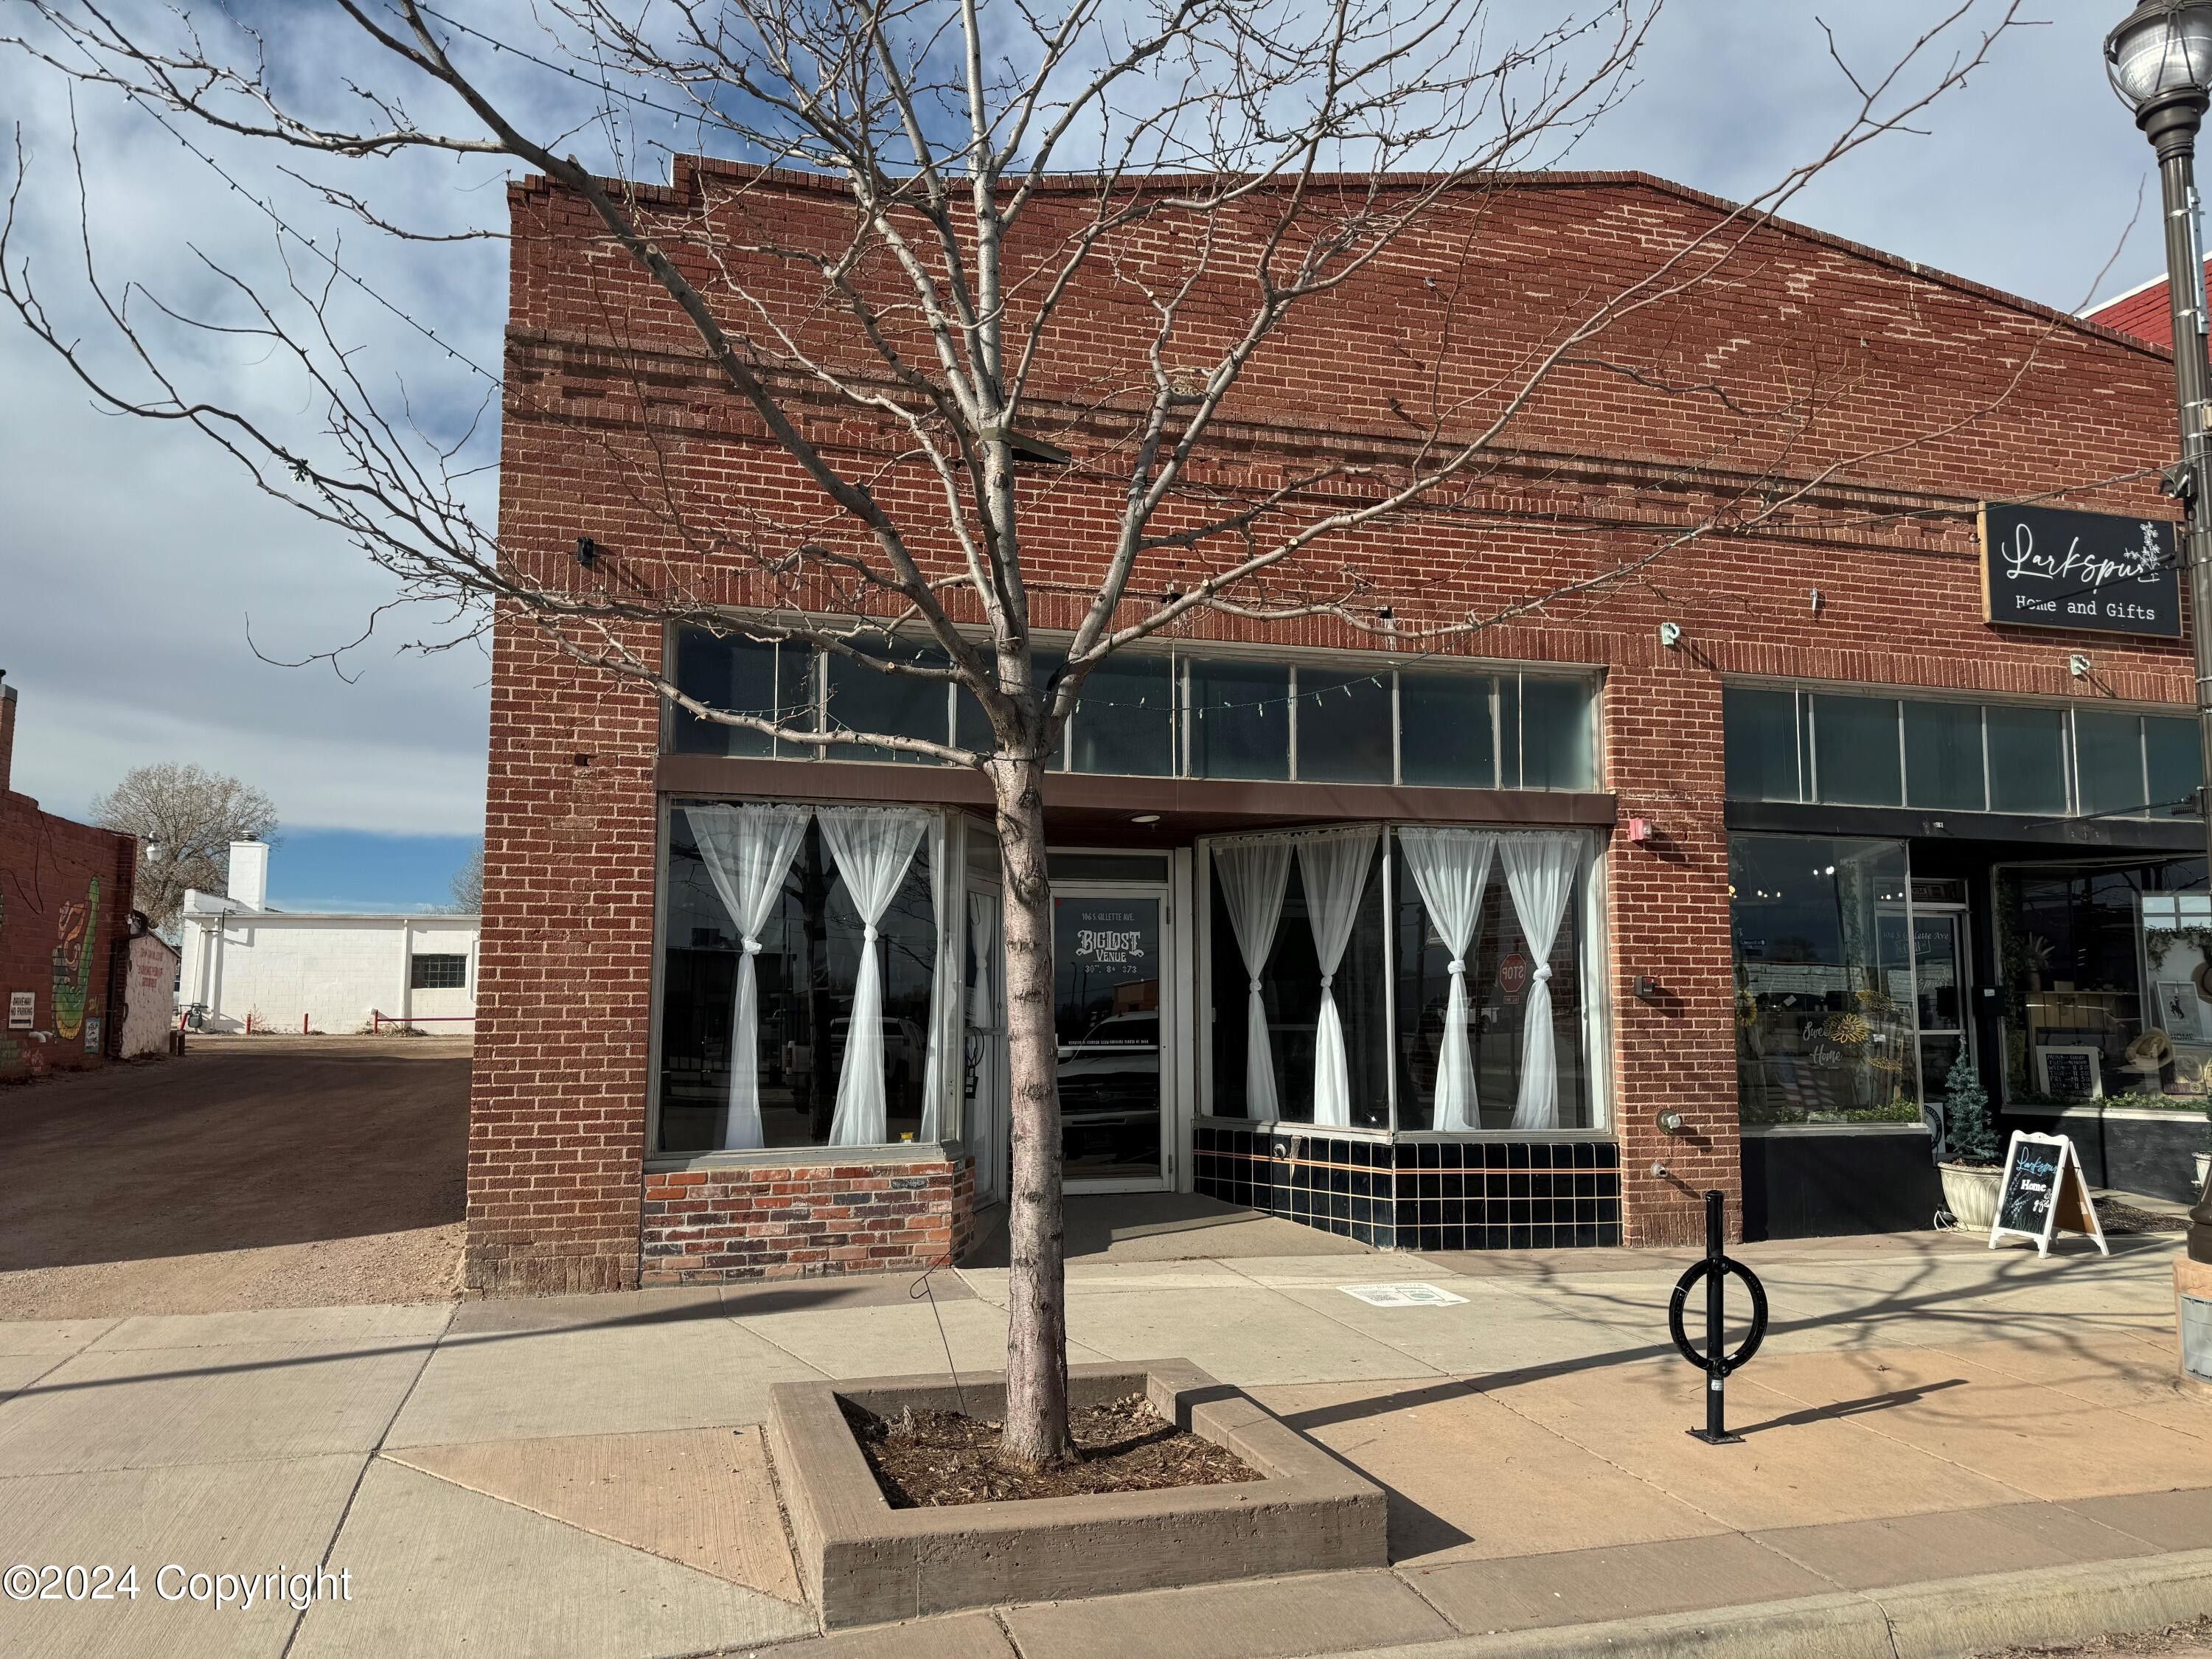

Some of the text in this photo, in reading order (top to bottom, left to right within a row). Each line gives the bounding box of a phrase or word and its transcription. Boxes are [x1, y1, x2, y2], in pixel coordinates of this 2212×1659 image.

[2001, 523, 2160, 594] Larkspur
[2015, 595, 2155, 620] Home and Gifts
[1082, 913, 1092, 921] 106
[1097, 913, 1122, 921] GILLETTE
[1902, 931, 1932, 939] Glette
[1095, 949, 1127, 962] VENUE
[11, 1007, 33, 1016] NO PARKING
[2171, 1032, 2194, 1040] HOME
[2020, 1178, 2047, 1192] Home
